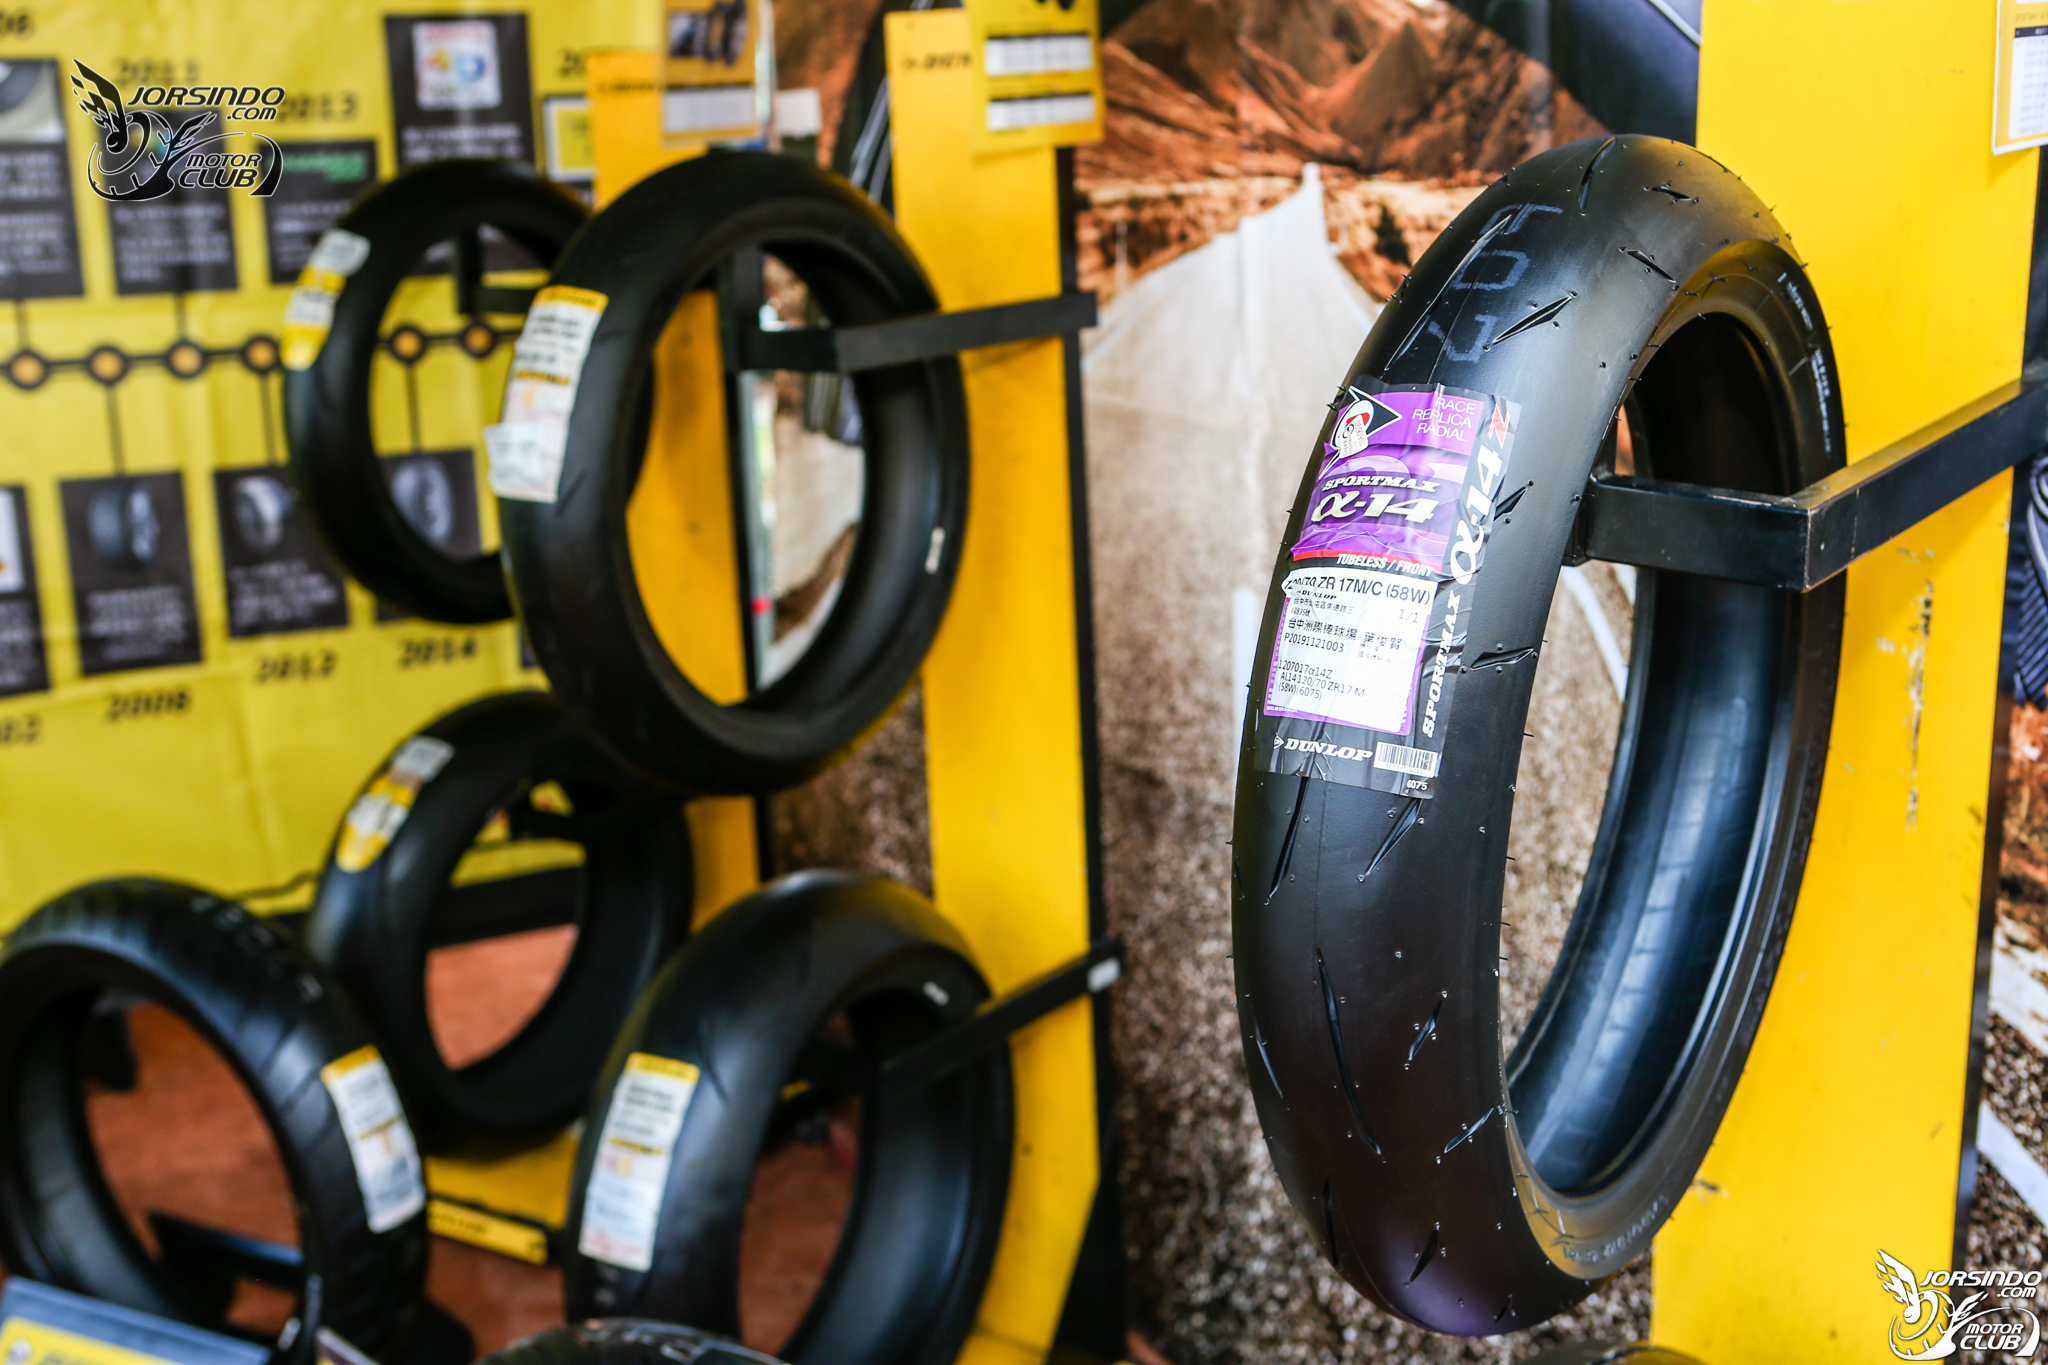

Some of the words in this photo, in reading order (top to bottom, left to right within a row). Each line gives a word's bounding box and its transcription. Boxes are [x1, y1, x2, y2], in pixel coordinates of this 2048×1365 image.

[1435, 397, 1477, 415] RACE
[1411, 408, 1472, 429] REPLICA
[1416, 421, 1468, 443] RADIAL
[1321, 475, 1441, 494] SPORTMAX
[1336, 553, 1388, 570] TUBELESS
[1394, 559, 1436, 578] FRONT
[1301, 589, 1337, 600] DUNLOP
[1317, 576, 1336, 590] ZR
[1339, 577, 1384, 596] 17M/C
[1385, 584, 1431, 606] (58W)
[1284, 632, 1345, 653] P20191121003
[1422, 589, 1461, 739] SPORTMAX
[1284, 737, 1374, 764] DUNLOP
[1406, 779, 1429, 791] 6075
